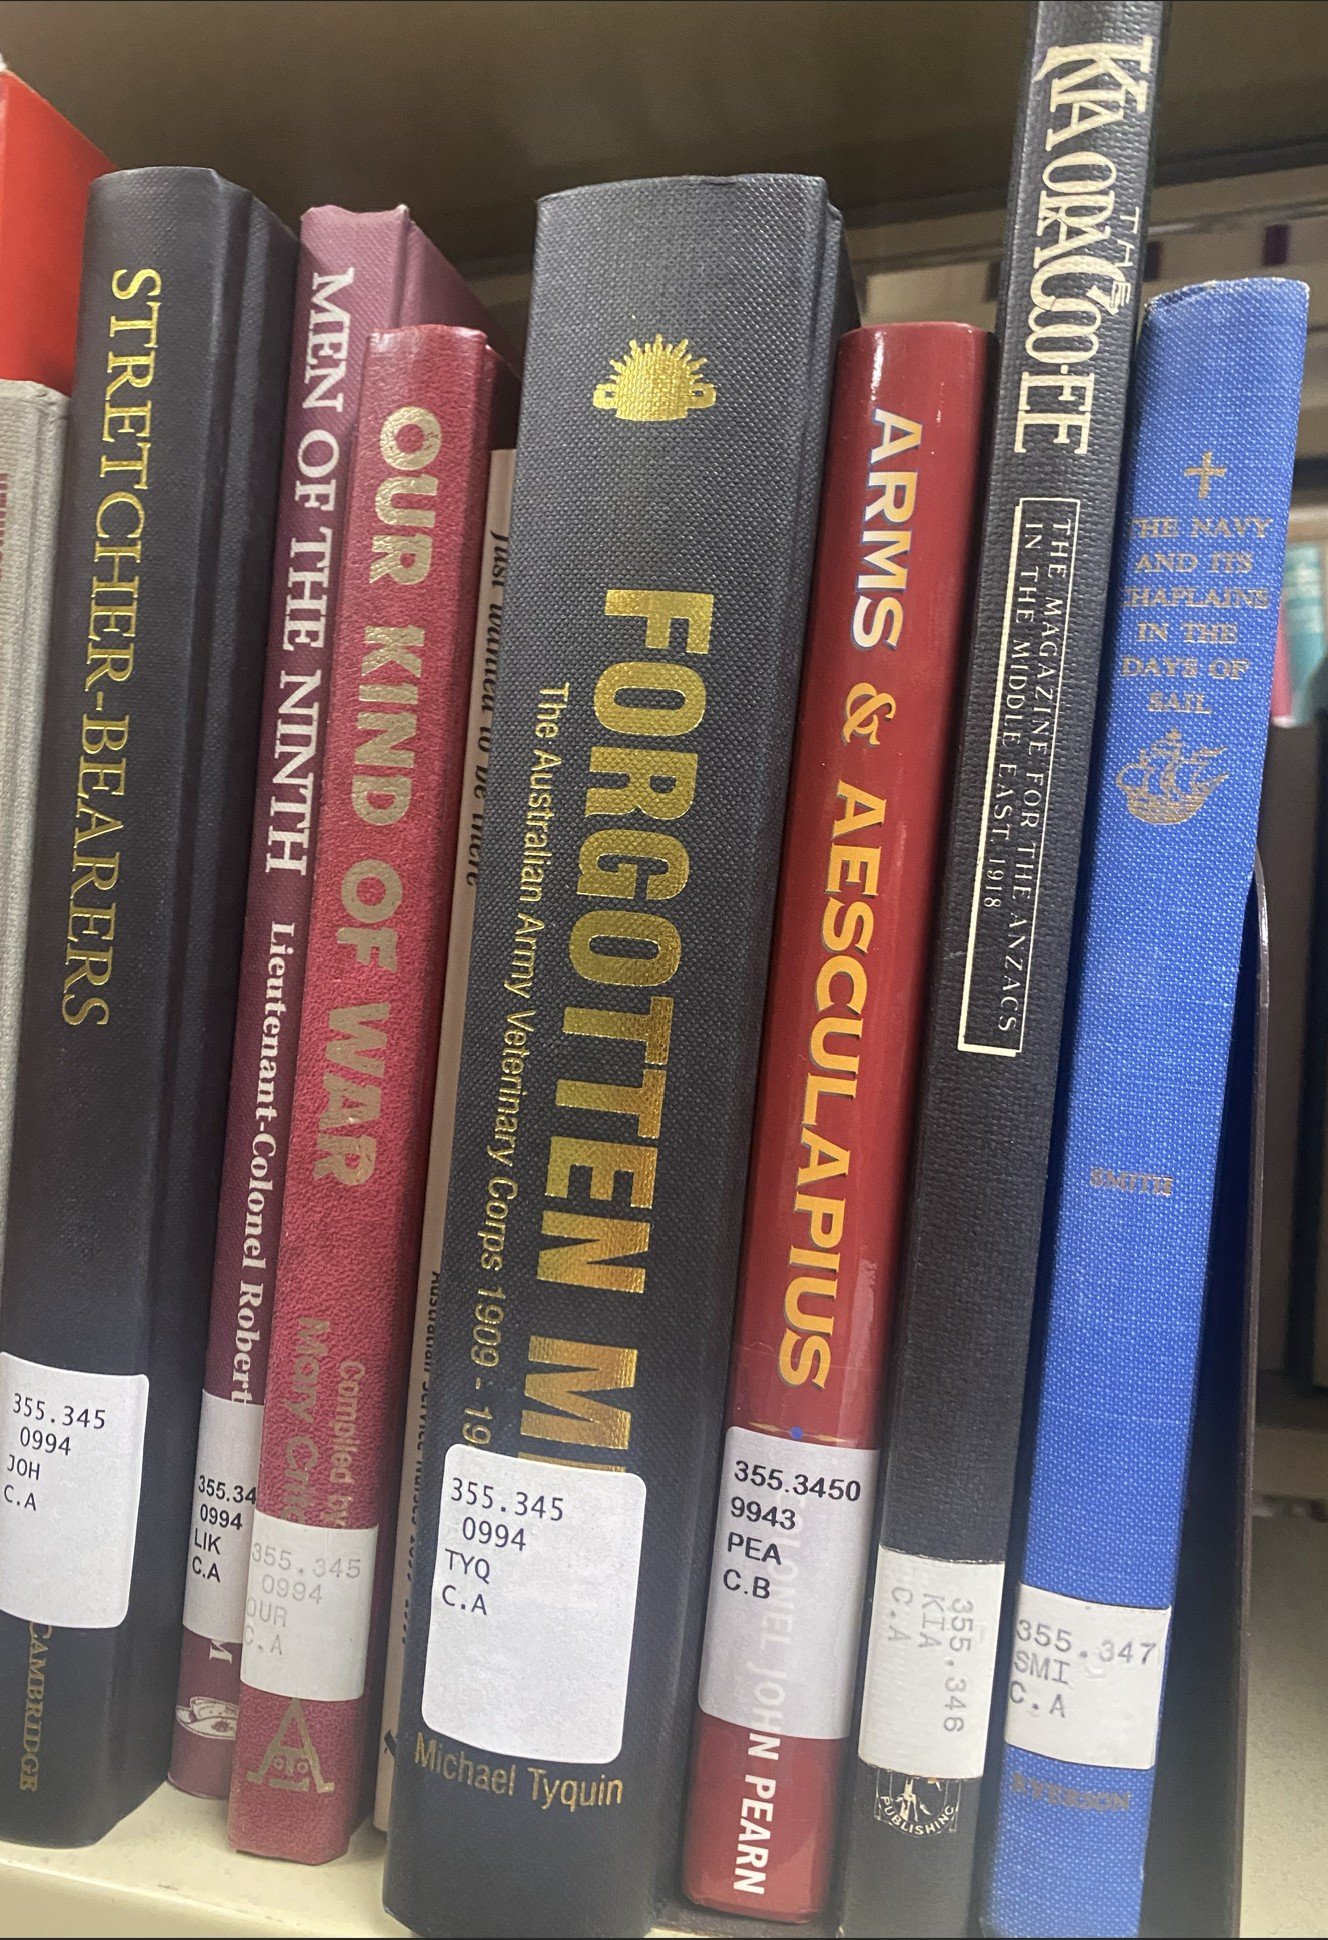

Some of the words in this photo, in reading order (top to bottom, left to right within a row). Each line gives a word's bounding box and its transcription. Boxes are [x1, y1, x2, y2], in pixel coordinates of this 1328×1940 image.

[1033, 34, 1153, 152] KIA
[1033, 151, 1117, 270] ORA
[1108, 206, 1141, 310] THE
[302, 266, 355, 412] MEN
[1014, 254, 1124, 454] COO-EE
[294, 429, 341, 511] OF
[369, 405, 443, 586] OUR
[852, 407, 925, 650] ARMS
[1025, 522, 1044, 549] IN
[1047, 519, 1072, 579] THE
[1191, 516, 1274, 538] NAVY
[281, 525, 333, 652] THE
[1134, 552, 1199, 573] AND
[1209, 552, 1253, 574] ITS
[1016, 566, 1039, 623] THE
[1122, 587, 1269, 609] HAPLAINS
[62, 267, 162, 1027] STRETCHER-BEARERS
[1137, 621, 1169, 642] IN
[1183, 622, 1238, 644] THE
[1000, 638, 1033, 747] MIDDLE
[1027, 596, 1064, 756] MAGAZINE
[1121, 655, 1198, 678] DAYS
[1208, 657, 1250, 680] OF
[351, 625, 426, 826] KIND
[534, 681, 571, 740] The
[841, 681, 898, 747] &
[1147, 691, 1212, 714] SAIL
[264, 669, 322, 876] NINTH
[1019, 772, 1045, 829] FOR
[519, 748, 563, 902] Australian
[983, 857, 1007, 909] 1918
[1012, 842, 1037, 901] THE
[336, 858, 403, 974] OF
[536, 588, 715, 1294] FORGOTTEN
[503, 912, 546, 998] Army
[998, 911, 1029, 1033] ANZACS
[241, 920, 296, 1269] Lieutenant-Colonel
[312, 1002, 391, 1186] WAR
[486, 1009, 537, 1168] Veterinary
[777, 780, 888, 1391] AESCULAPIUS
[479, 1177, 519, 1272] Corps
[231, 1280, 264, 1405] Robert
[470, 1287, 506, 1368] 1909
[282, 1316, 332, 1424] Mary
[13, 1392, 106, 1430] 355.345
[329, 1359, 367, 1485] Compiled
[518, 1335, 638, 1473] M
[7, 1453, 41, 1481] JOH
[20, 1426, 72, 1456] 0994
[3, 1484, 37, 1512] C.A
[197, 1474, 257, 1505] 355.34
[320, 1494, 353, 1527] by
[450, 1476, 564, 1522] 355.345
[733, 1459, 862, 1503] 355.3450
[193, 1527, 222, 1556] LIK
[200, 1502, 243, 1531] 0994
[462, 1516, 527, 1552] 0994
[730, 1495, 798, 1531] 9943
[191, 1555, 222, 1583] C.A
[251, 1541, 362, 1580] 355.345
[444, 1547, 491, 1586] TYQ
[727, 1531, 782, 1567] PEA
[261, 1573, 323, 1606] 0994
[441, 1584, 488, 1616] C.A
[722, 1568, 772, 1600] C.B
[243, 1623, 283, 1656] C.A
[888, 1586, 914, 1642] C.A
[919, 1592, 946, 1649] KIA
[1016, 1618, 1157, 1665] 355.347
[943, 1597, 974, 1733] 355.346
[1013, 1649, 1071, 1686] SMI
[746, 1661, 787, 1761] JOHN
[1009, 1679, 1066, 1719] C.A
[414, 1731, 517, 1797] Michael
[527, 1766, 624, 1813] Tyquin
[733, 1774, 777, 1895] PEARN
